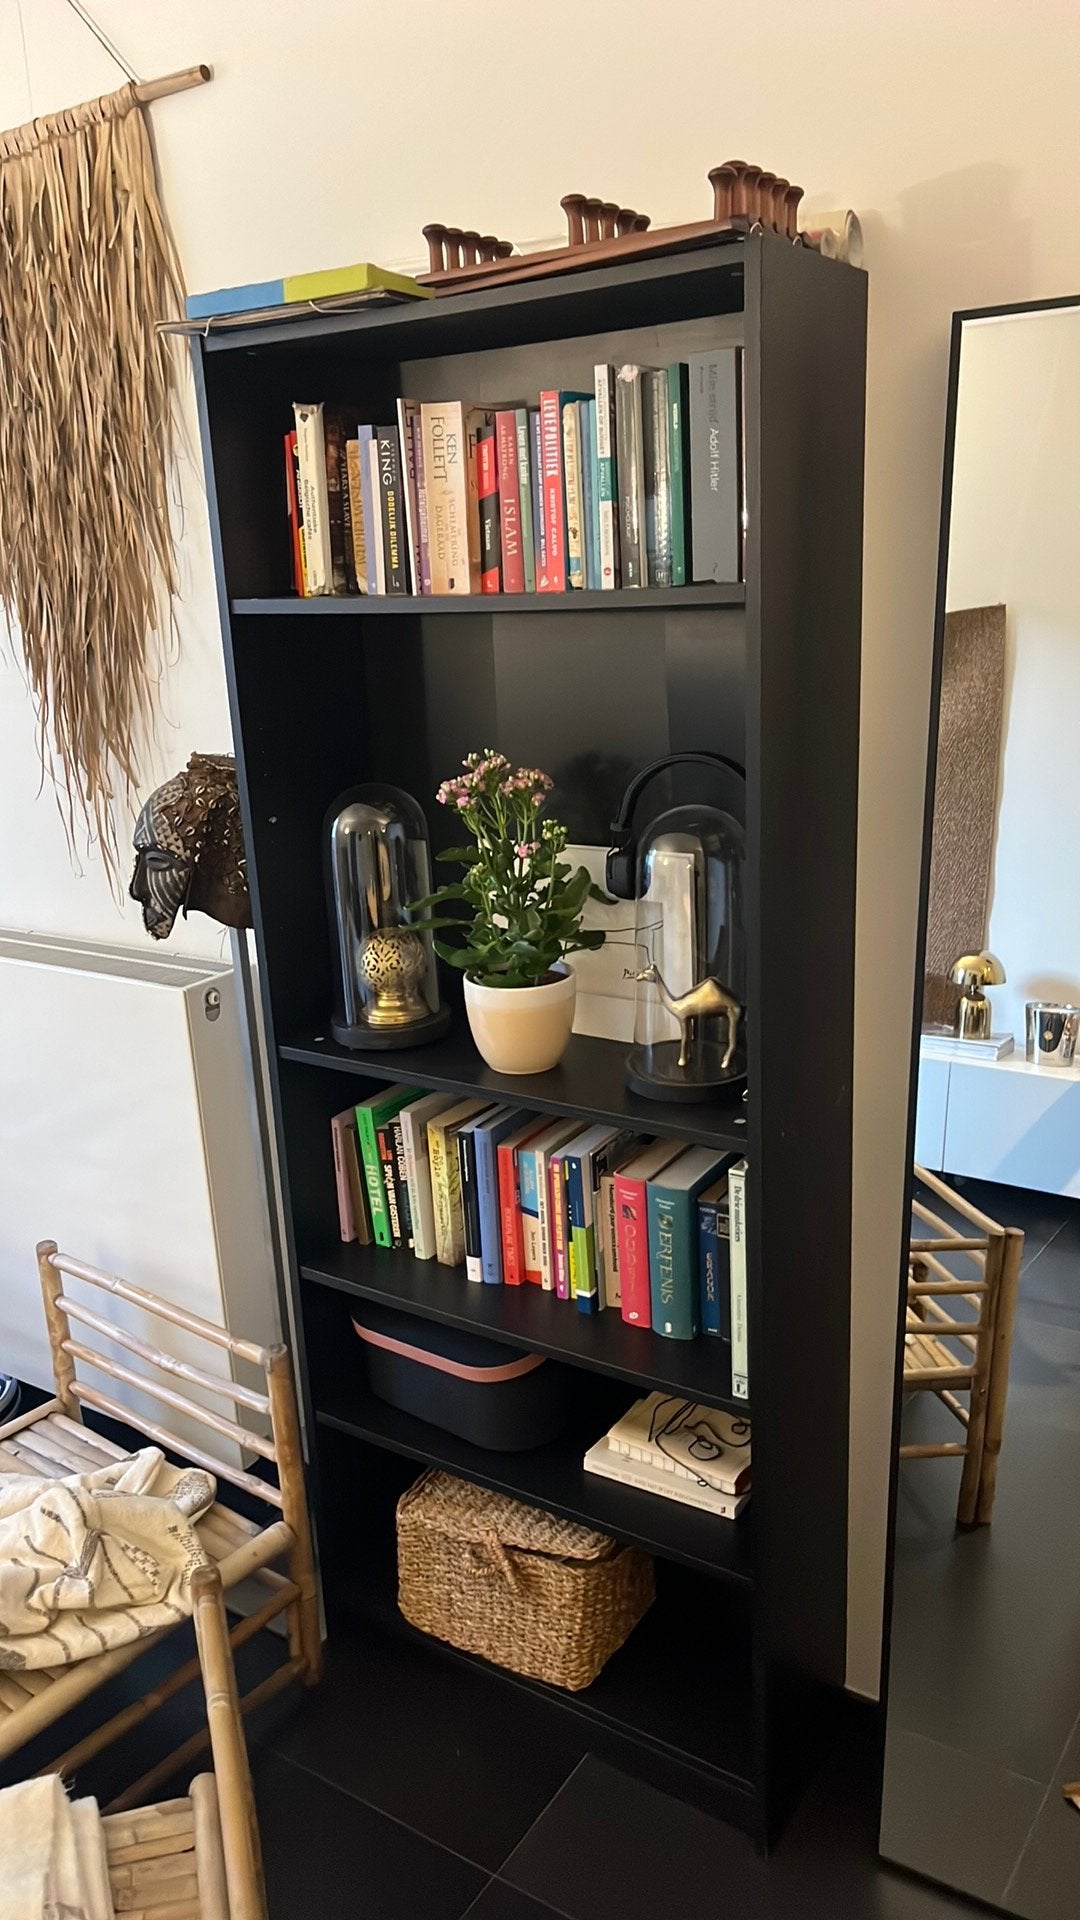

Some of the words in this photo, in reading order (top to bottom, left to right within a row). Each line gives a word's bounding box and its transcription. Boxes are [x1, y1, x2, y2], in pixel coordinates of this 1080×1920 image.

[431, 417, 447, 482] FOLLETT
[447, 433, 458, 463] KEN
[518, 426, 526, 448] Leven
[710, 428, 719, 458] Adolf
[380, 440, 393, 485] KING
[500, 425, 508, 480] ARMSTRONG
[519, 449, 527, 460] met
[340, 462, 348, 490] YEARS
[519, 462, 528, 485] kanker
[710, 461, 720, 492] Hitler
[343, 501, 351, 527] SLAVE
[387, 491, 395, 529] DODELIJK
[549, 488, 557, 525] KRISTOF
[435, 506, 445, 560] DAGERAAD
[448, 497, 458, 566] SCHEMERING
[504, 499, 518, 556] ISLAM
[389, 531, 399, 569] DILEMMA
[394, 1126, 404, 1154] HARLAN
[365, 1164, 382, 1215] HOTEL
[383, 1164, 395, 1189] SPION
[734, 1185, 742, 1195] De
[388, 1190, 398, 1204] VAN
[734, 1195, 742, 1207] drie
[656, 1231, 674, 1304] ERFENIS
